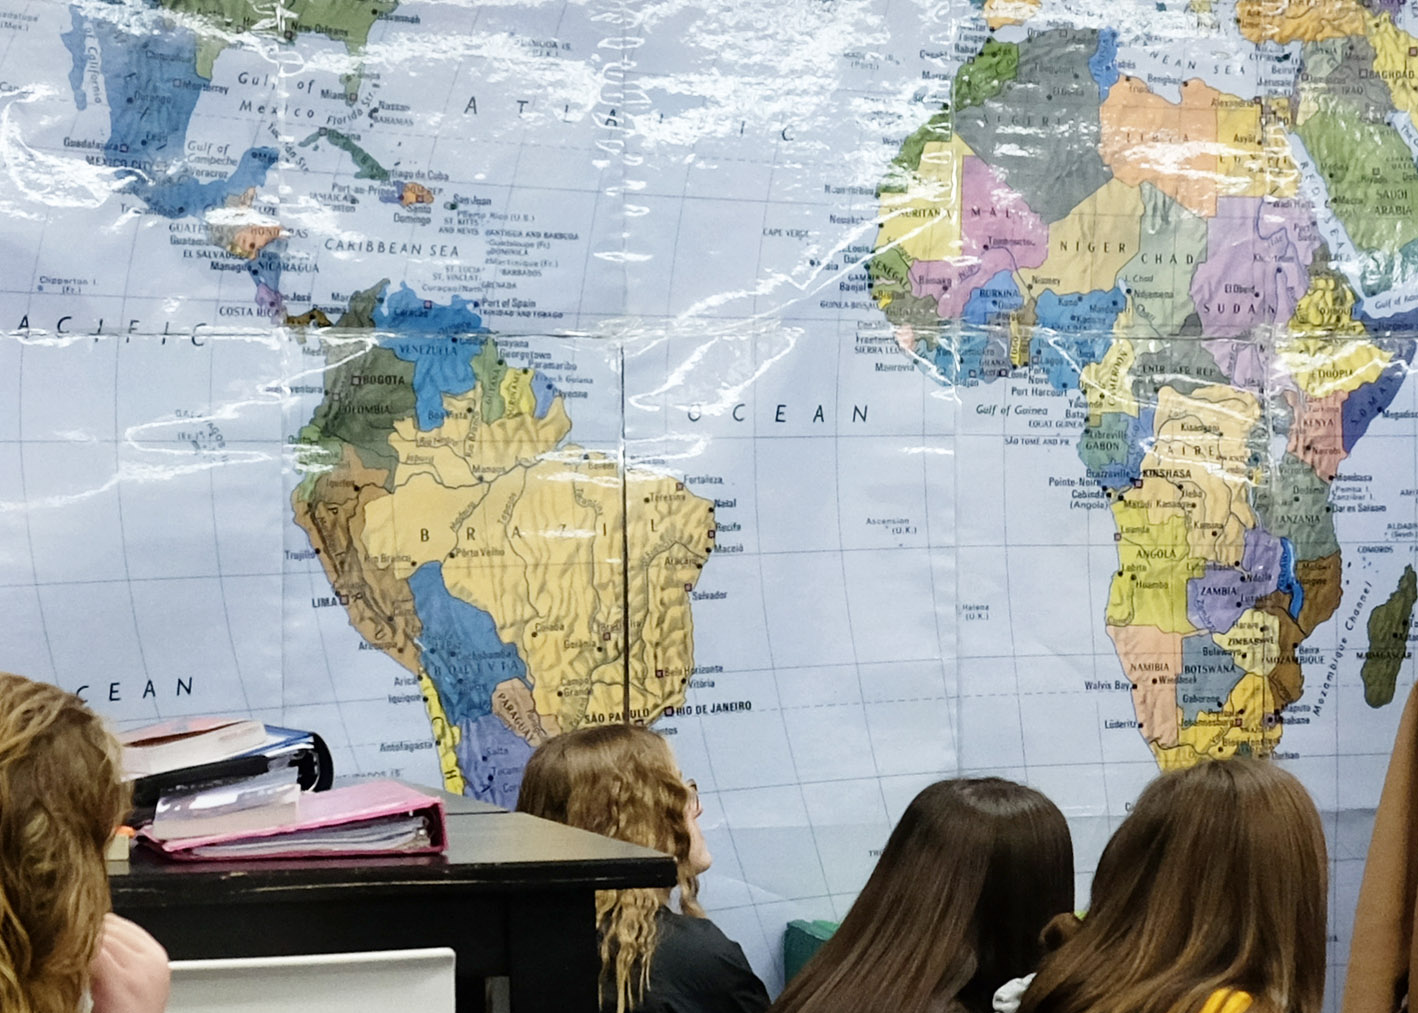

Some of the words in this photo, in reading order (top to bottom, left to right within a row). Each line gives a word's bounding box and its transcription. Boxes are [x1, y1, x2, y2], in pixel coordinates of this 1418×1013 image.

[1214, 64, 1246, 75] SEA
[298, 80, 314, 93] of
[240, 101, 314, 118] Mexico
[464, 96, 794, 142] ATLAIC
[187, 141, 212, 153] Gulf
[219, 144, 229, 154] of
[1376, 190, 1408, 200] SAUDI
[1375, 207, 1413, 217] ARABIA
[324, 239, 426, 257] CARIBBEAN
[429, 243, 459, 257] SEA
[1060, 241, 1125, 253] NIGER
[1142, 253, 1194, 264] CHAD
[481, 299, 498, 309] Port
[500, 299, 508, 308] of
[511, 299, 535, 310] Spain
[1203, 303, 1275, 315] SUDAN
[219, 306, 253, 316] COSTA
[500, 350, 552, 361] Georgetown
[528, 360, 577, 371] Paramaribo
[688, 404, 868, 423] OCEAN
[976, 404, 996, 416] Gulf
[1001, 404, 1011, 415] of
[1086, 442, 1119, 451] GABON
[714, 498, 737, 508] Natal
[1070, 500, 1109, 511] (Angola)
[716, 522, 741, 532] Recife
[1136, 549, 1176, 558] ANGOLA
[692, 591, 727, 601] Salvador
[1200, 586, 1237, 596] ZAMBIA
[312, 598, 338, 609] LIMA
[1345, 579, 1374, 632] Channel
[1130, 662, 1169, 672] NAMIBIA
[1185, 664, 1236, 675] BOTSWANA
[394, 677, 417, 687] Arica
[1084, 681, 1112, 691] Walvis
[1115, 682, 1130, 691] Bay
[77, 677, 193, 701] CEAN
[675, 706, 692, 717] RIO
[695, 704, 709, 715] DE
[710, 701, 752, 714] JANEIRO
